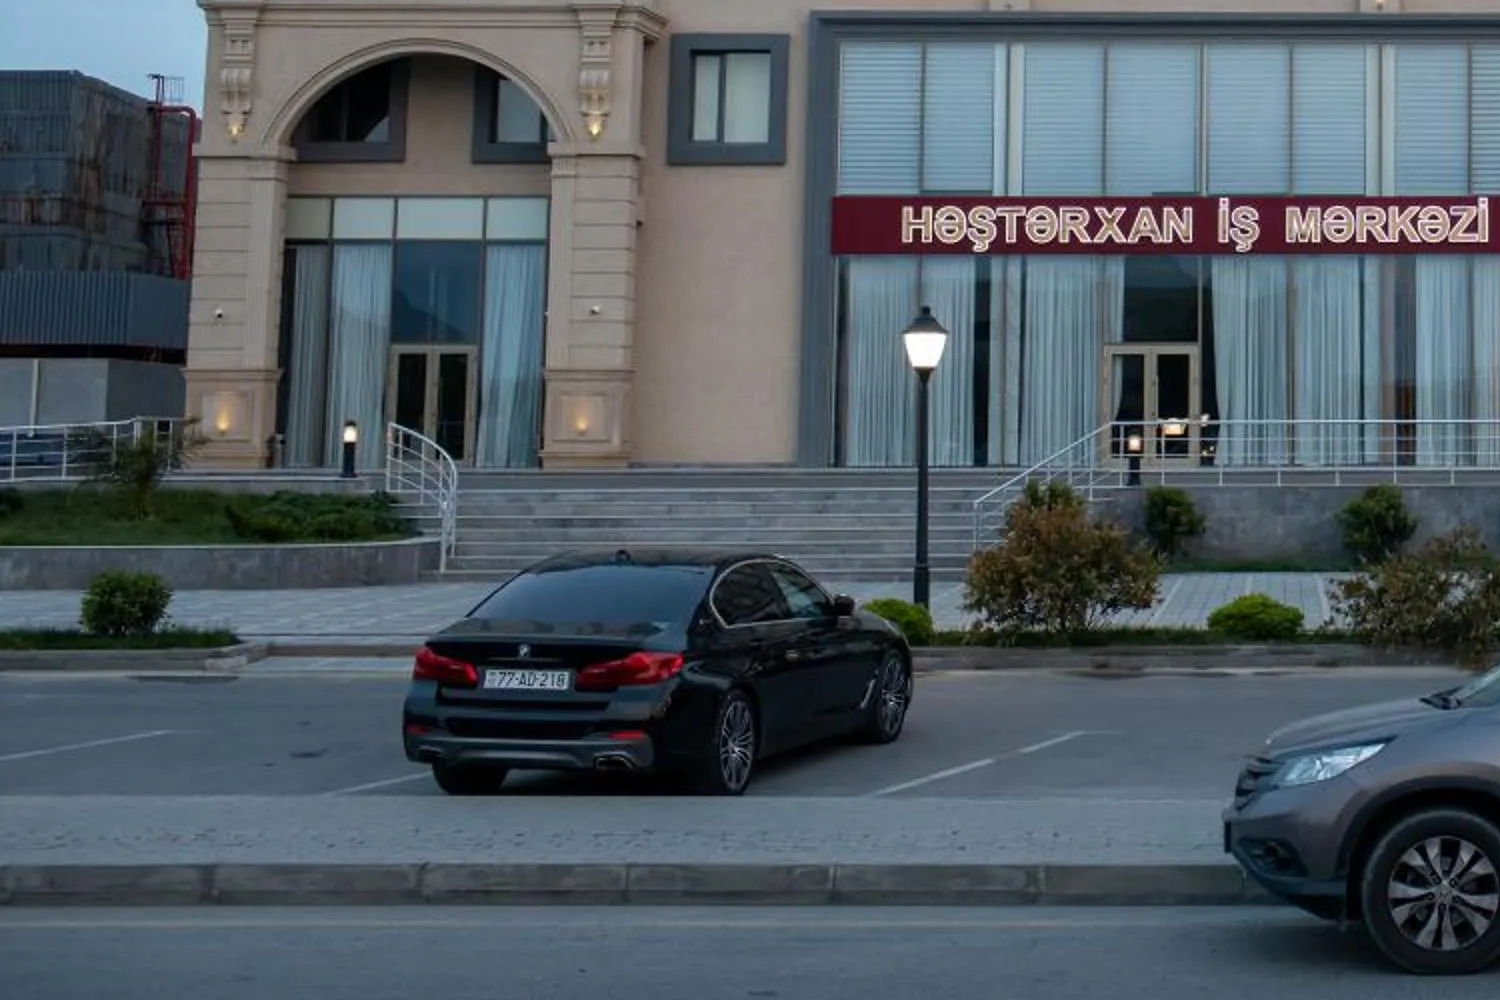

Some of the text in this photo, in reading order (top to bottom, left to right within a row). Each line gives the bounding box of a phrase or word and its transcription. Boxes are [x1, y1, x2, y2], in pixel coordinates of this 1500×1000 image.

[901, 198, 1489, 252] HƏŞTƏRXAN İŞ MƏRKƏZİ
